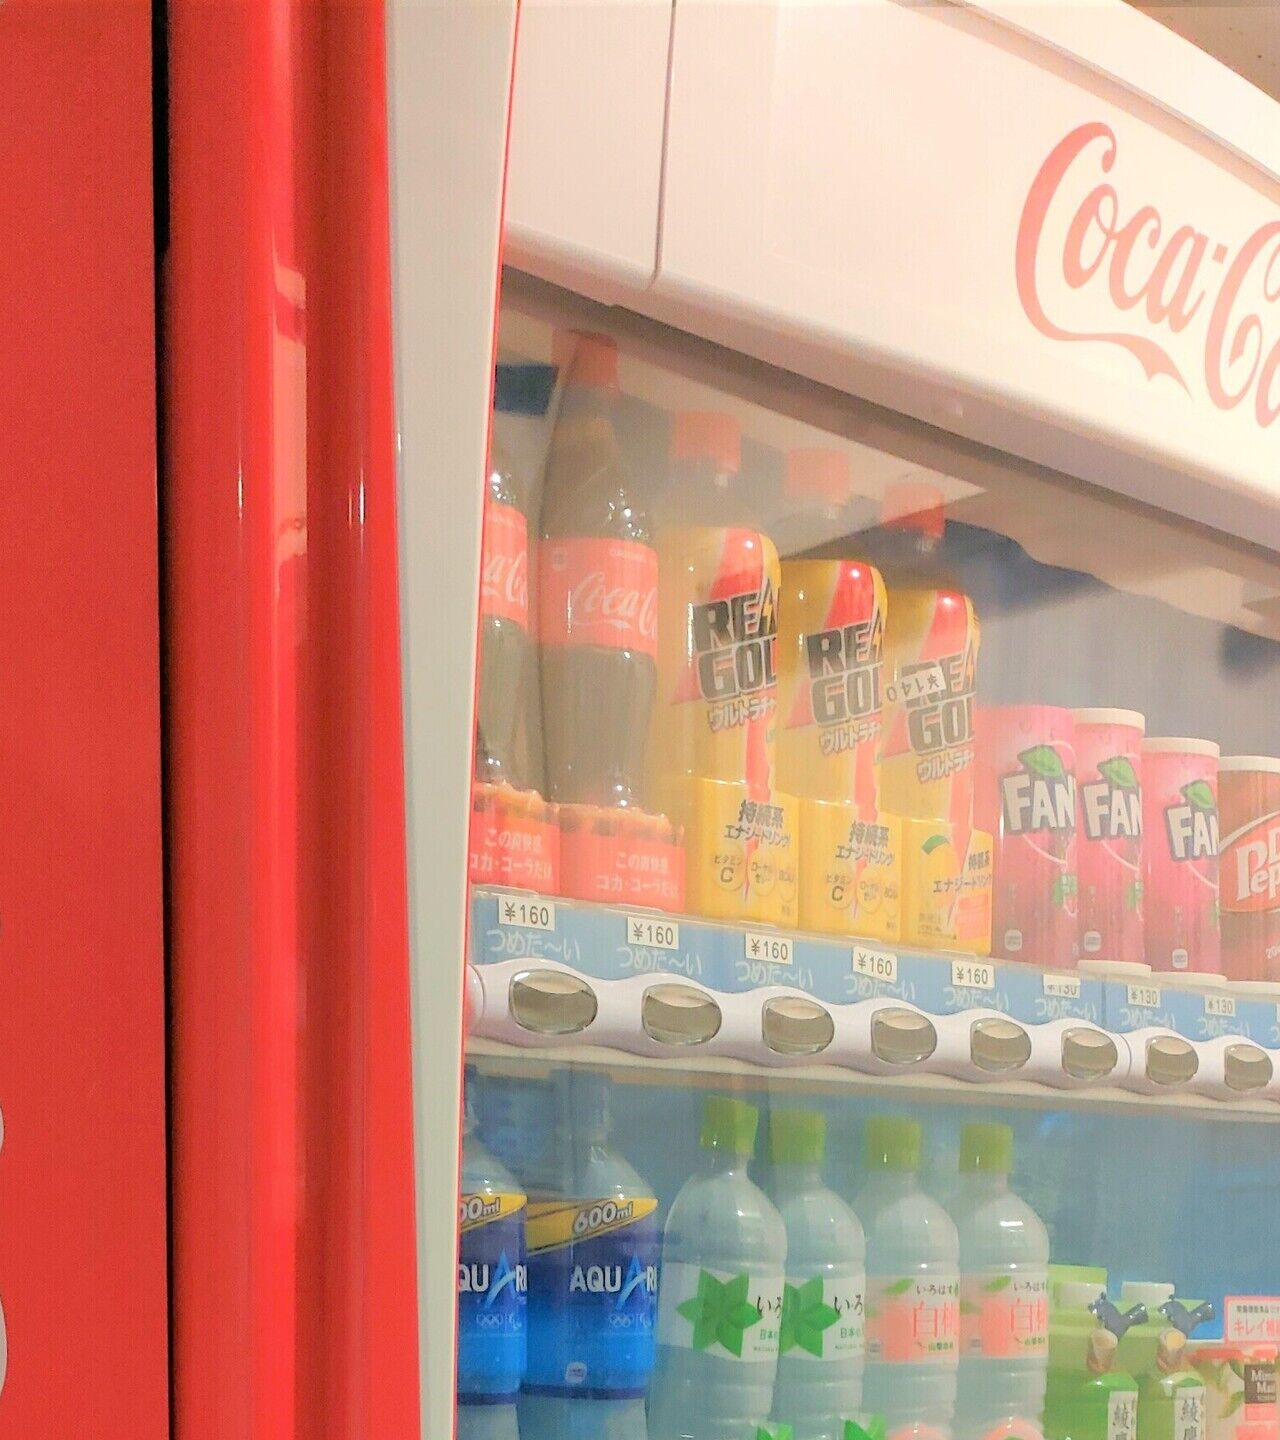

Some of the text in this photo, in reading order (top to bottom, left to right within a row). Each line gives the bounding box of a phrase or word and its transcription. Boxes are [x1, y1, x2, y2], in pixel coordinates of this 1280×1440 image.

[719, 867, 734, 884] C
[831, 885, 844, 902] C
[503, 901, 550, 927] ¥160
[632, 923, 674, 946] ¥160
[751, 938, 789, 961] ¥160
[857, 954, 893, 977] ¥160
[955, 966, 989, 985] ¥160
[1131, 988, 1159, 1006] ¥130
[1207, 1000, 1234, 1014] ¥130
[574, 1201, 634, 1233] 600ml
